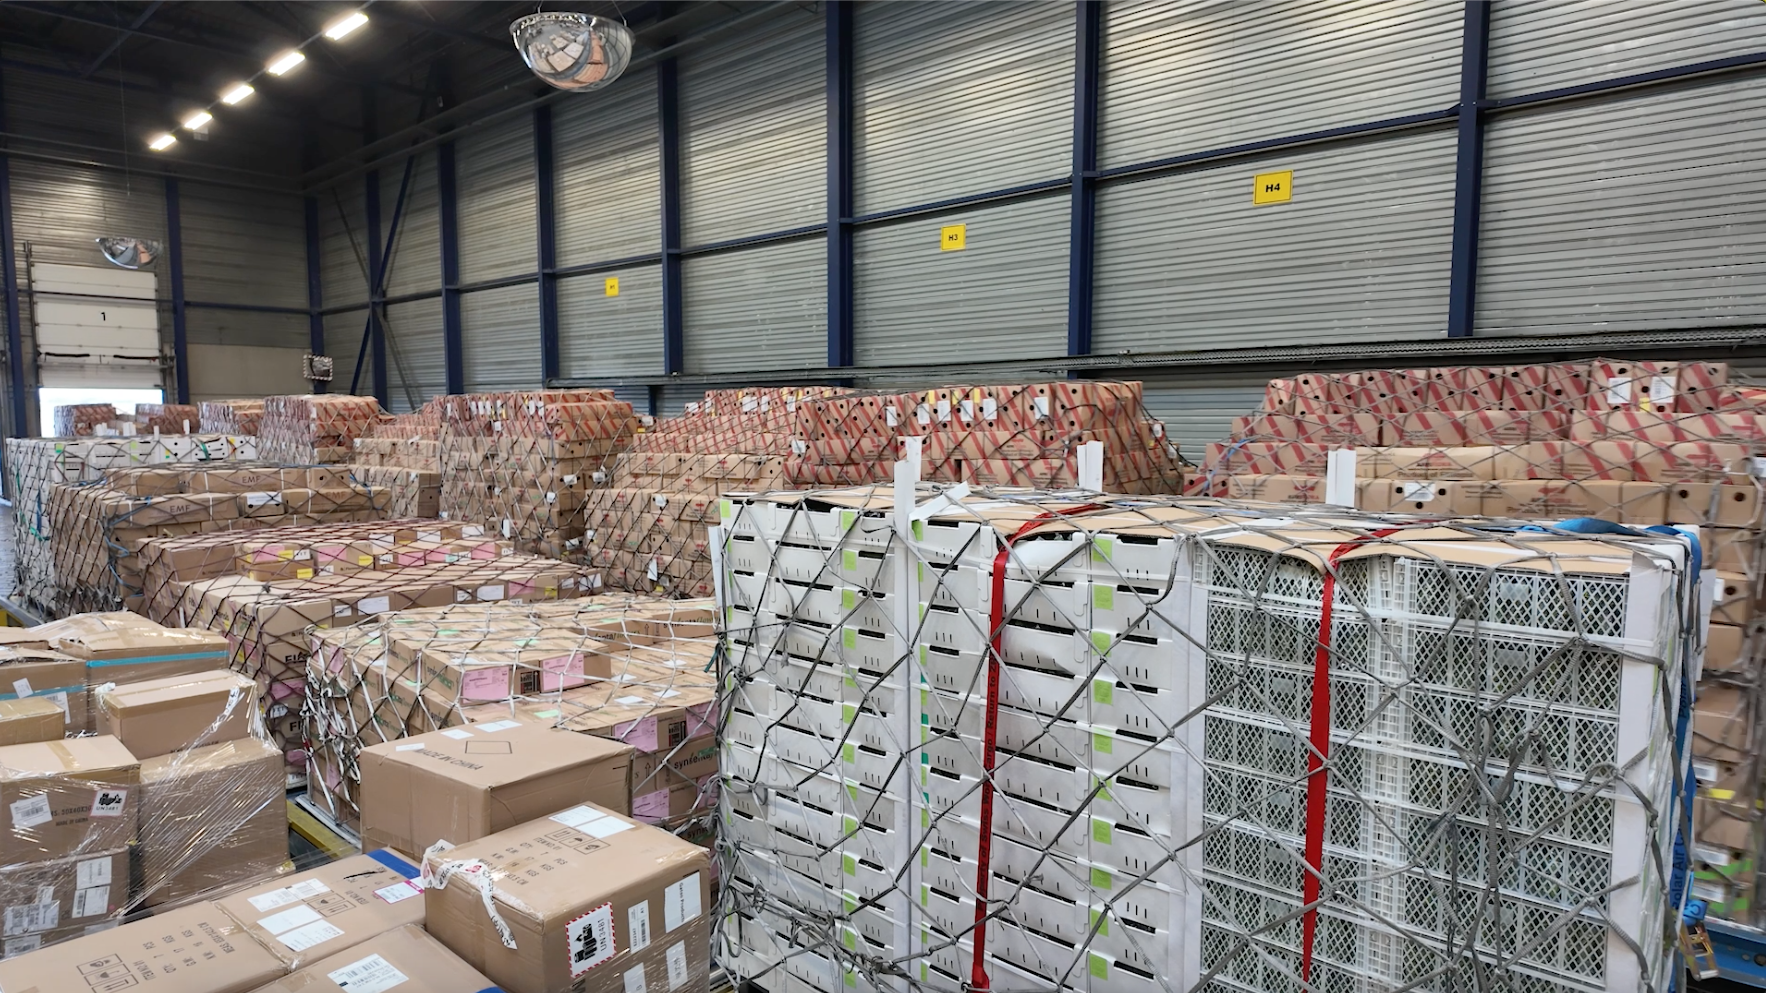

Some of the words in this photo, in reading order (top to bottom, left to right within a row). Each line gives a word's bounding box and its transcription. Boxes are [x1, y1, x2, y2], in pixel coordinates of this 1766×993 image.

[1265, 182, 1280, 193] H4
[948, 233, 958, 241] H3
[101, 312, 106, 321] 1
[242, 476, 261, 484] EMF
[169, 504, 191, 513] EMF
[987, 691, 995, 729] Return
[1672, 852, 1685, 870] Air
